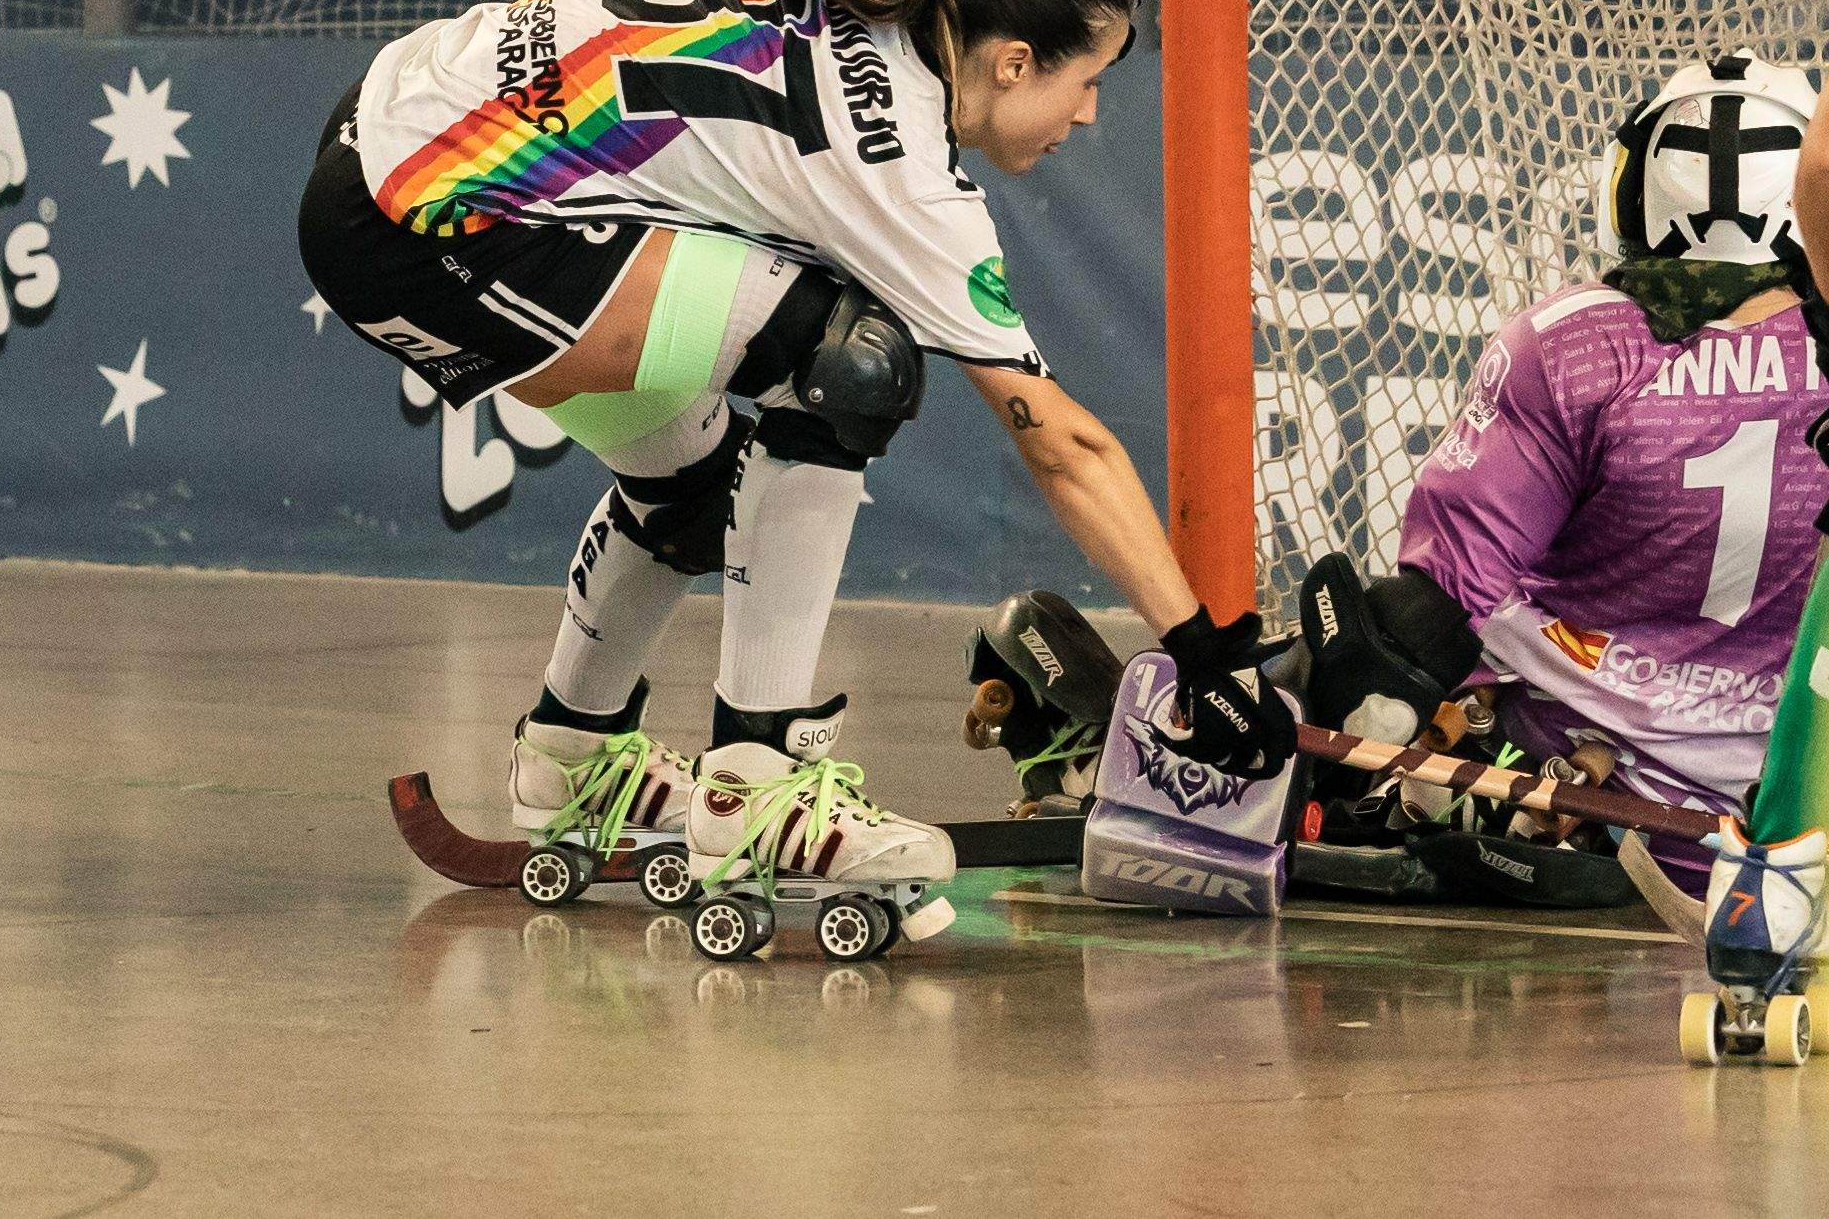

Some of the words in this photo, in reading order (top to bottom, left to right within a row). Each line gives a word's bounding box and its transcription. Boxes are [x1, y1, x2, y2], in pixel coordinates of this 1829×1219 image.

[1636, 335, 1789, 399] ANNA
[1683, 419, 1779, 628] 1
[1605, 643, 1784, 702] GOBIERNO
[1205, 690, 1250, 734] AZEMAD
[1647, 689, 1774, 733] ARAGO
[797, 722, 841, 748] SIOU
[1728, 889, 1757, 927] 7
